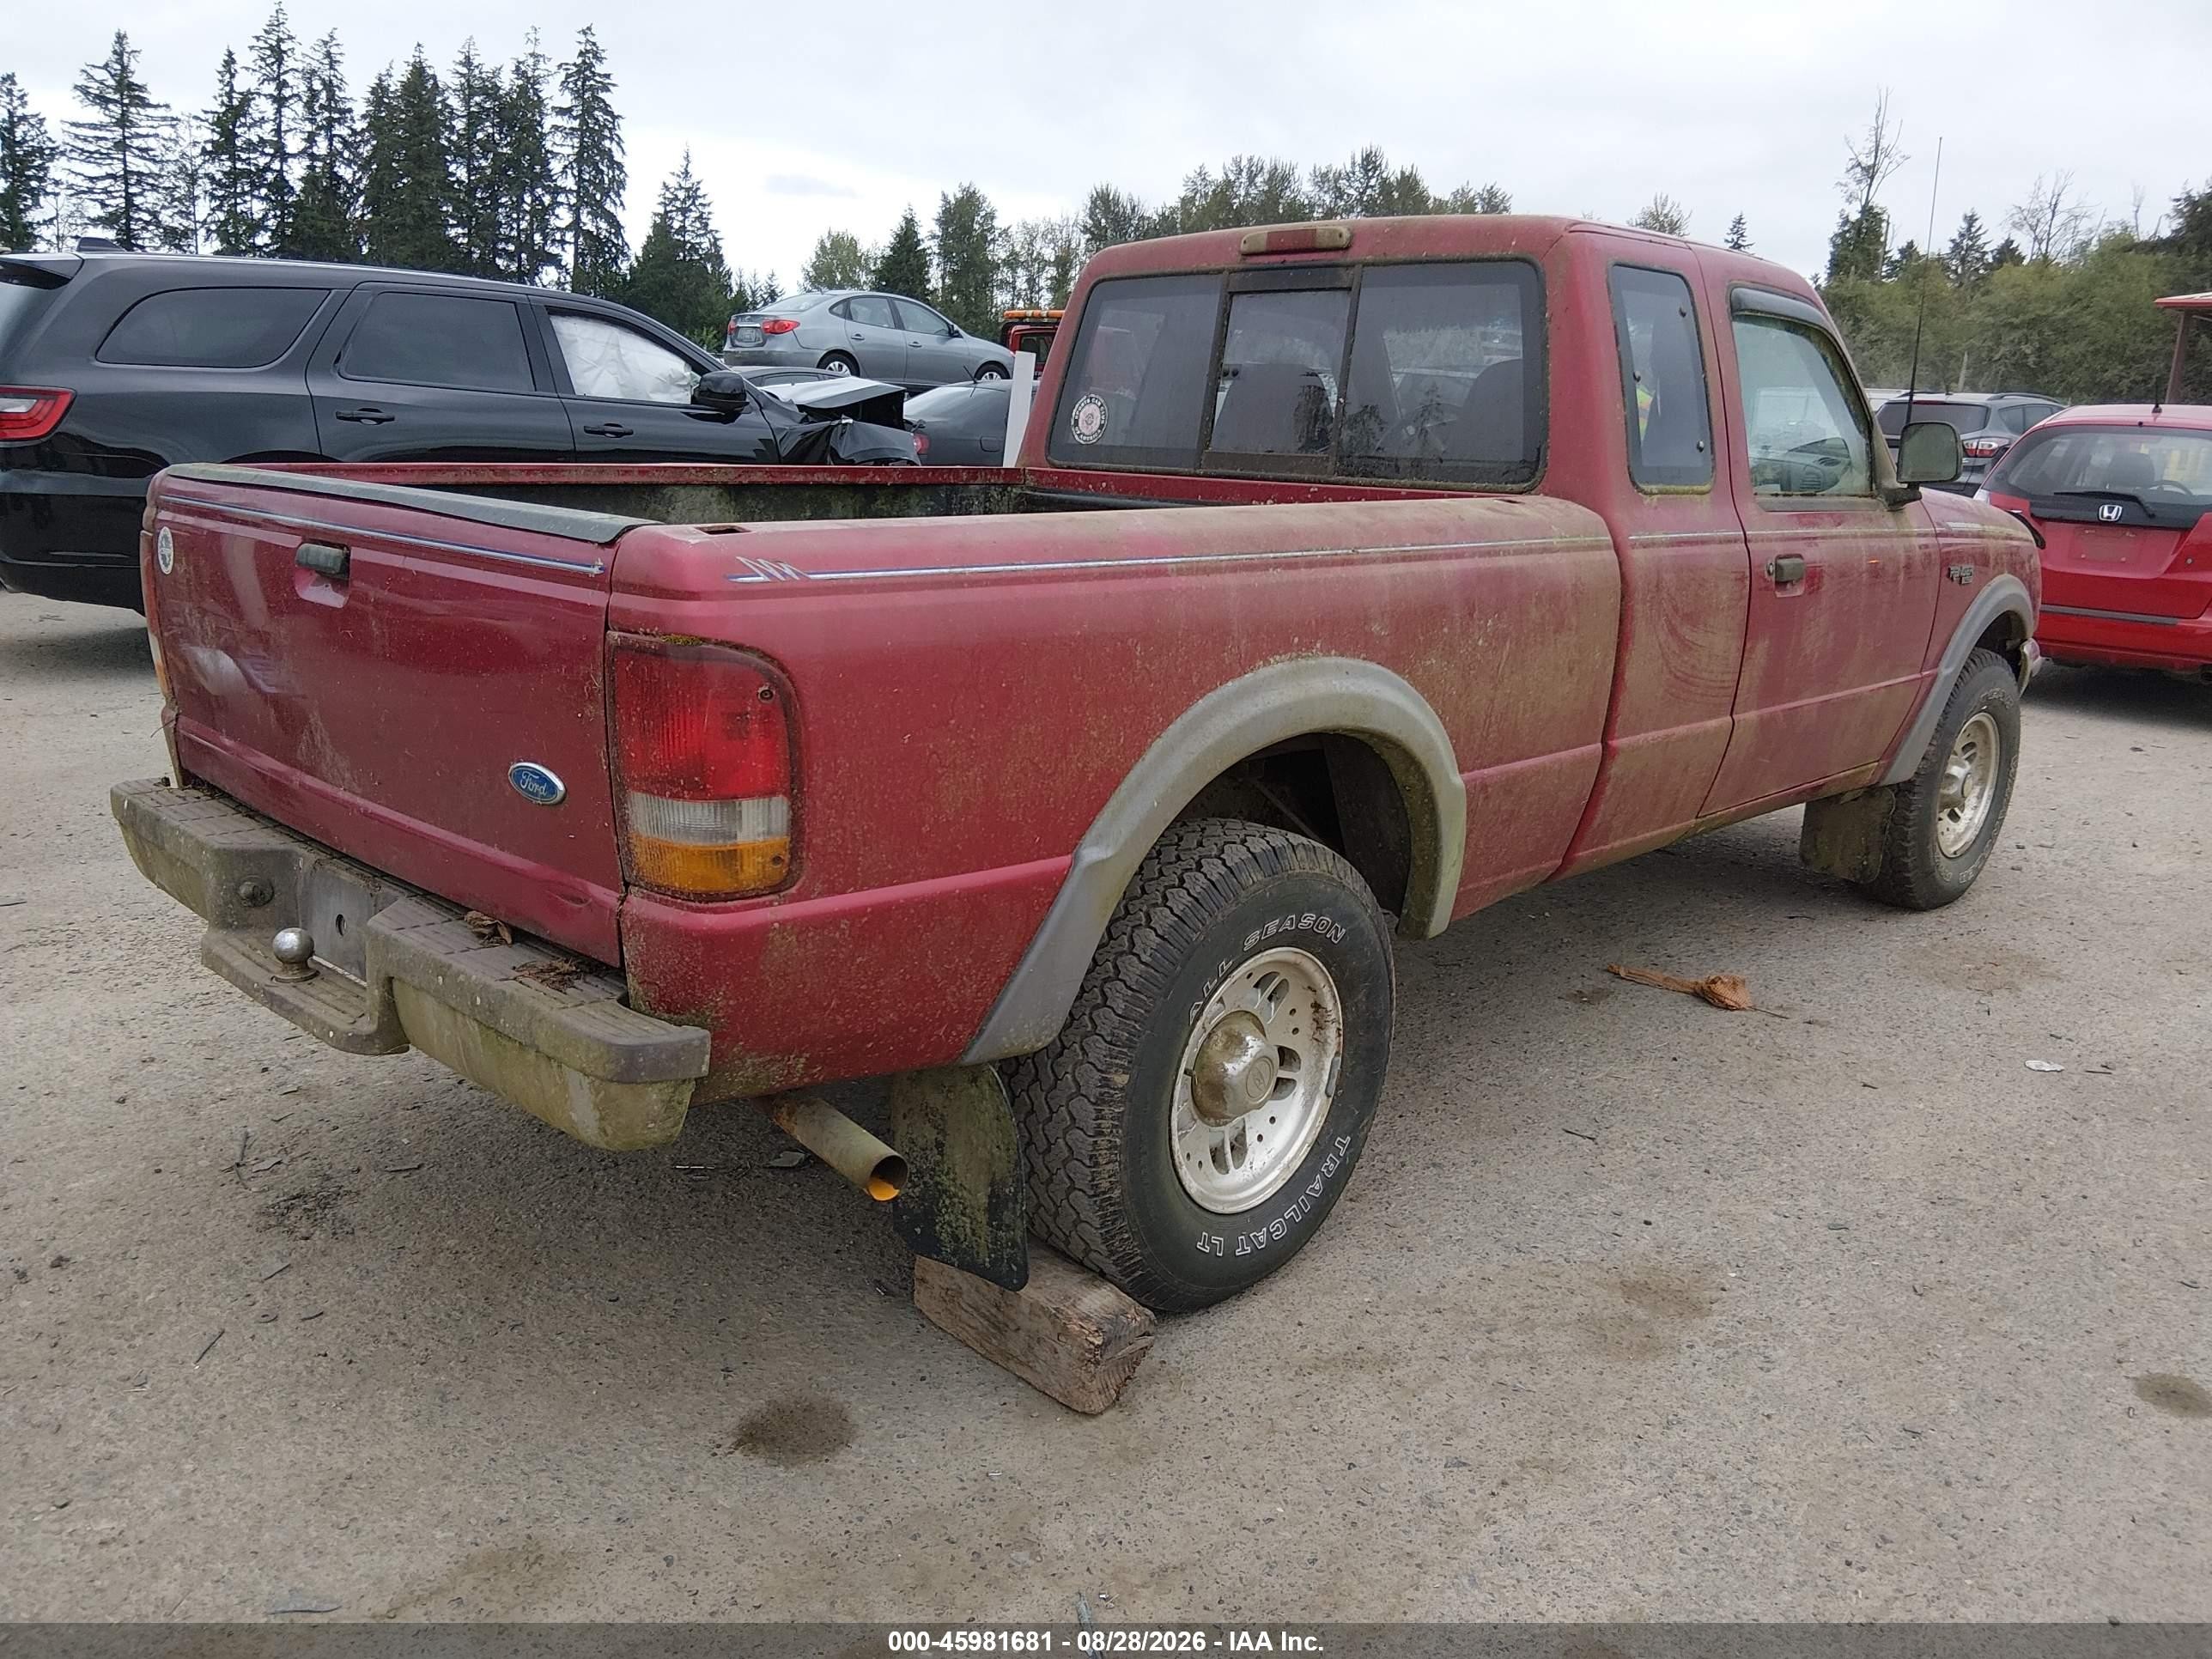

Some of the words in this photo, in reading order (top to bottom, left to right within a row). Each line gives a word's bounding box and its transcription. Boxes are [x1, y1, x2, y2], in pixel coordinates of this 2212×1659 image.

[520, 771, 548, 796] Ford
[1188, 957, 1234, 1025] ALL
[1243, 914, 1346, 952] SEASON
[1235, 1134, 1351, 1256] TRAILCAT
[1196, 1232, 1224, 1256] LT
